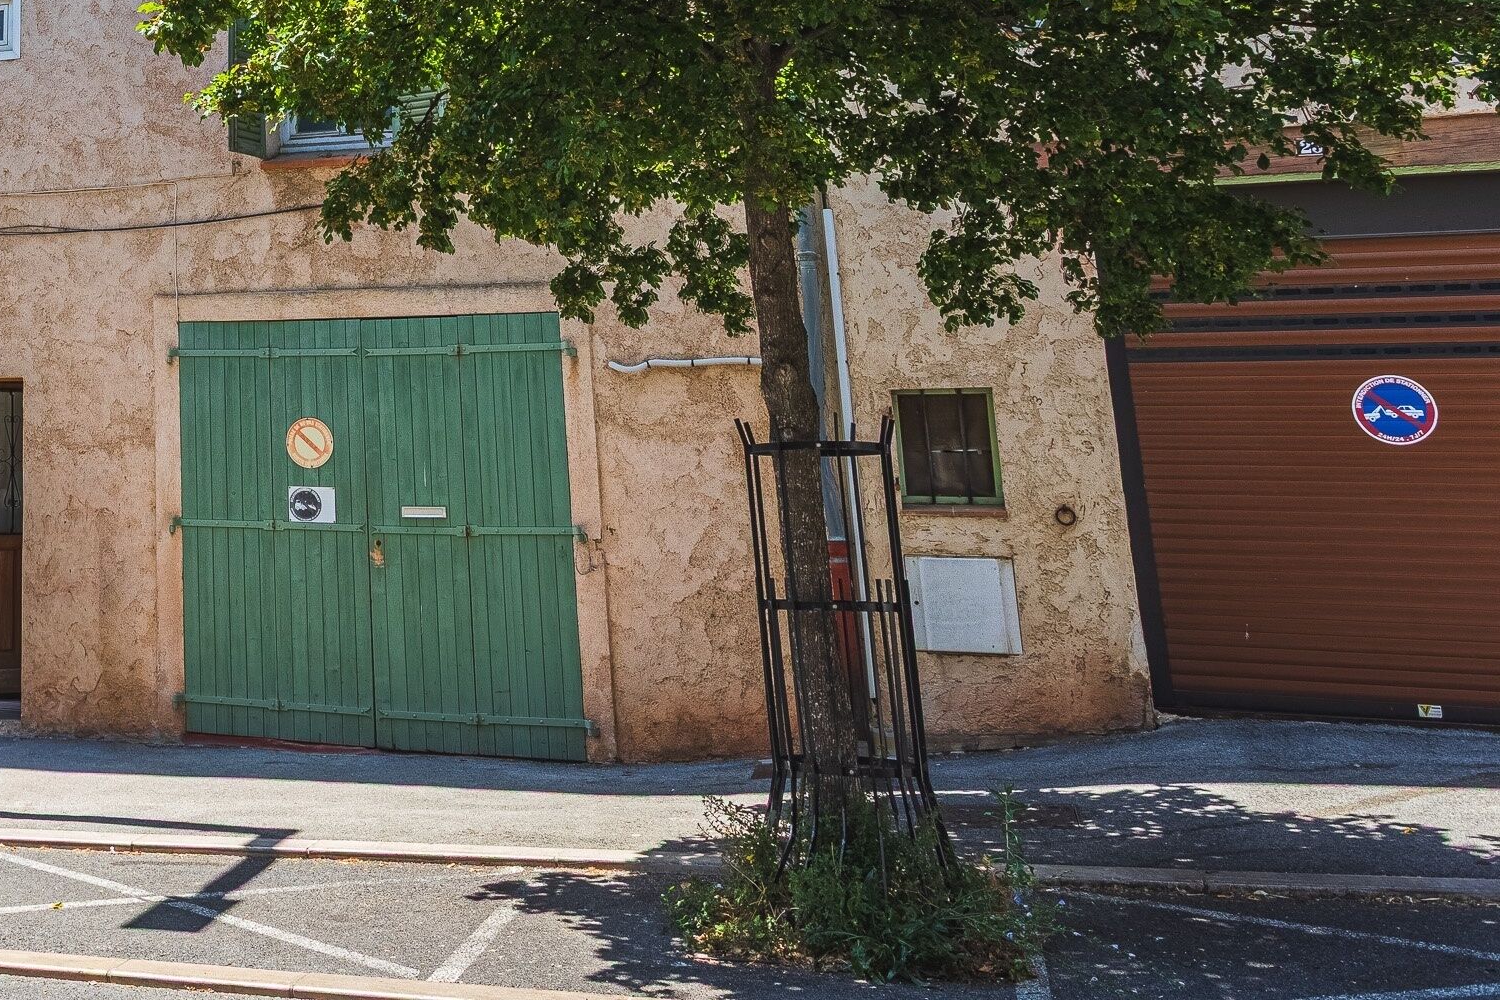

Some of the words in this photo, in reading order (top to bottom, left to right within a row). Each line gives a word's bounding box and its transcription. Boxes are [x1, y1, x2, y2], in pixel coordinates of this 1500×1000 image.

[1355, 378, 1385, 409] INTERDICTION
[1395, 378, 1431, 404] STATIONNER
[1377, 432, 1405, 442] 24H/24
